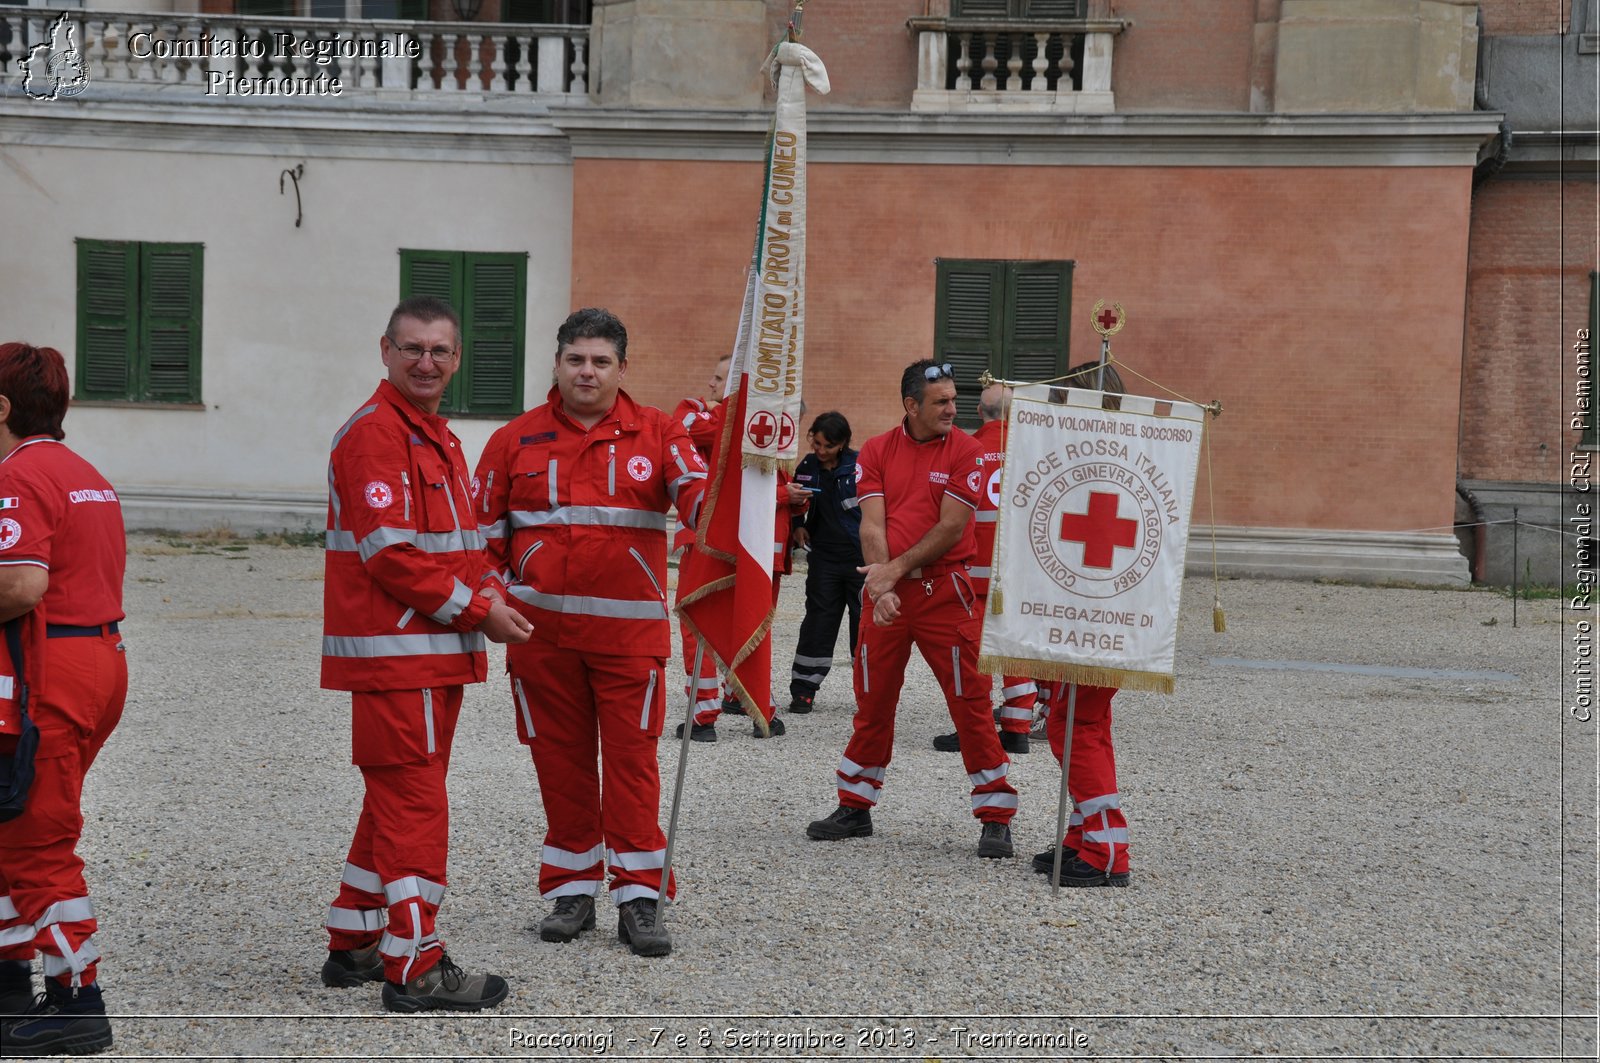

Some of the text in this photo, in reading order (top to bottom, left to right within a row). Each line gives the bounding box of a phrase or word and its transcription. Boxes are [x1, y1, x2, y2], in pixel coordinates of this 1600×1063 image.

[754, 292, 787, 393] COMITATO
[771, 131, 797, 205] CUNEO
[1017, 410, 1192, 443] CORPO VOLONTARI DEL SOCCORSO
[1012, 452, 1063, 508] CROCE
[1065, 439, 1128, 461] ROSSA
[1135, 452, 1179, 526] ITALIANA
[1033, 465, 1159, 592] CONVENZIONE DI GINEVRA 22 AGOSTO 1864
[1021, 602, 1153, 628] DELEGAZIONE DI
[1048, 628, 1125, 651] BARGE
